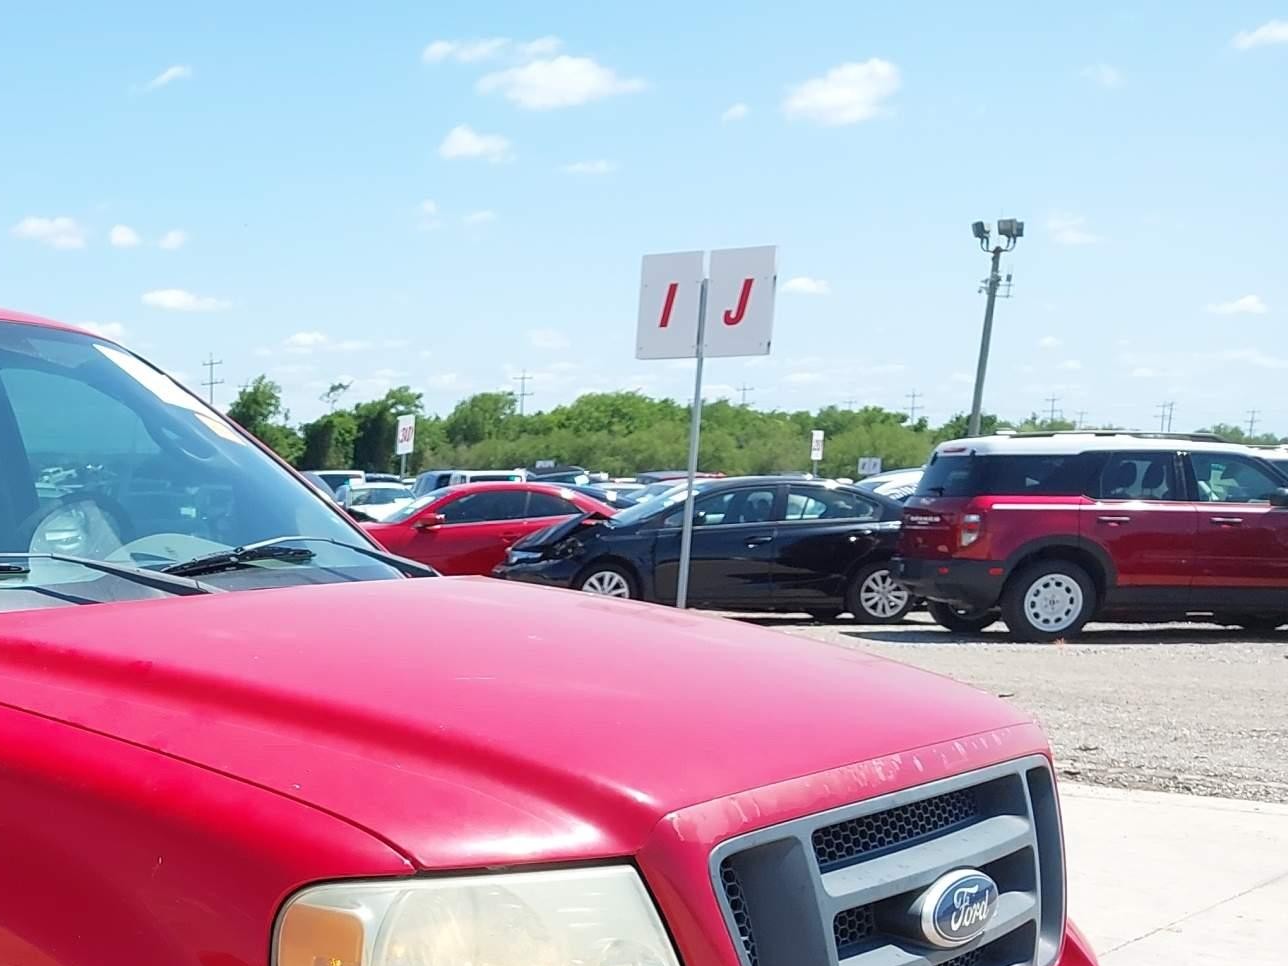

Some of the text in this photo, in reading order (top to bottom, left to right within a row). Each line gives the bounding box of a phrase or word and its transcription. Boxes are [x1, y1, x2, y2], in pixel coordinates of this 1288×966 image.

[659, 278, 755, 328] I J
[950, 884, 990, 931] Ford
